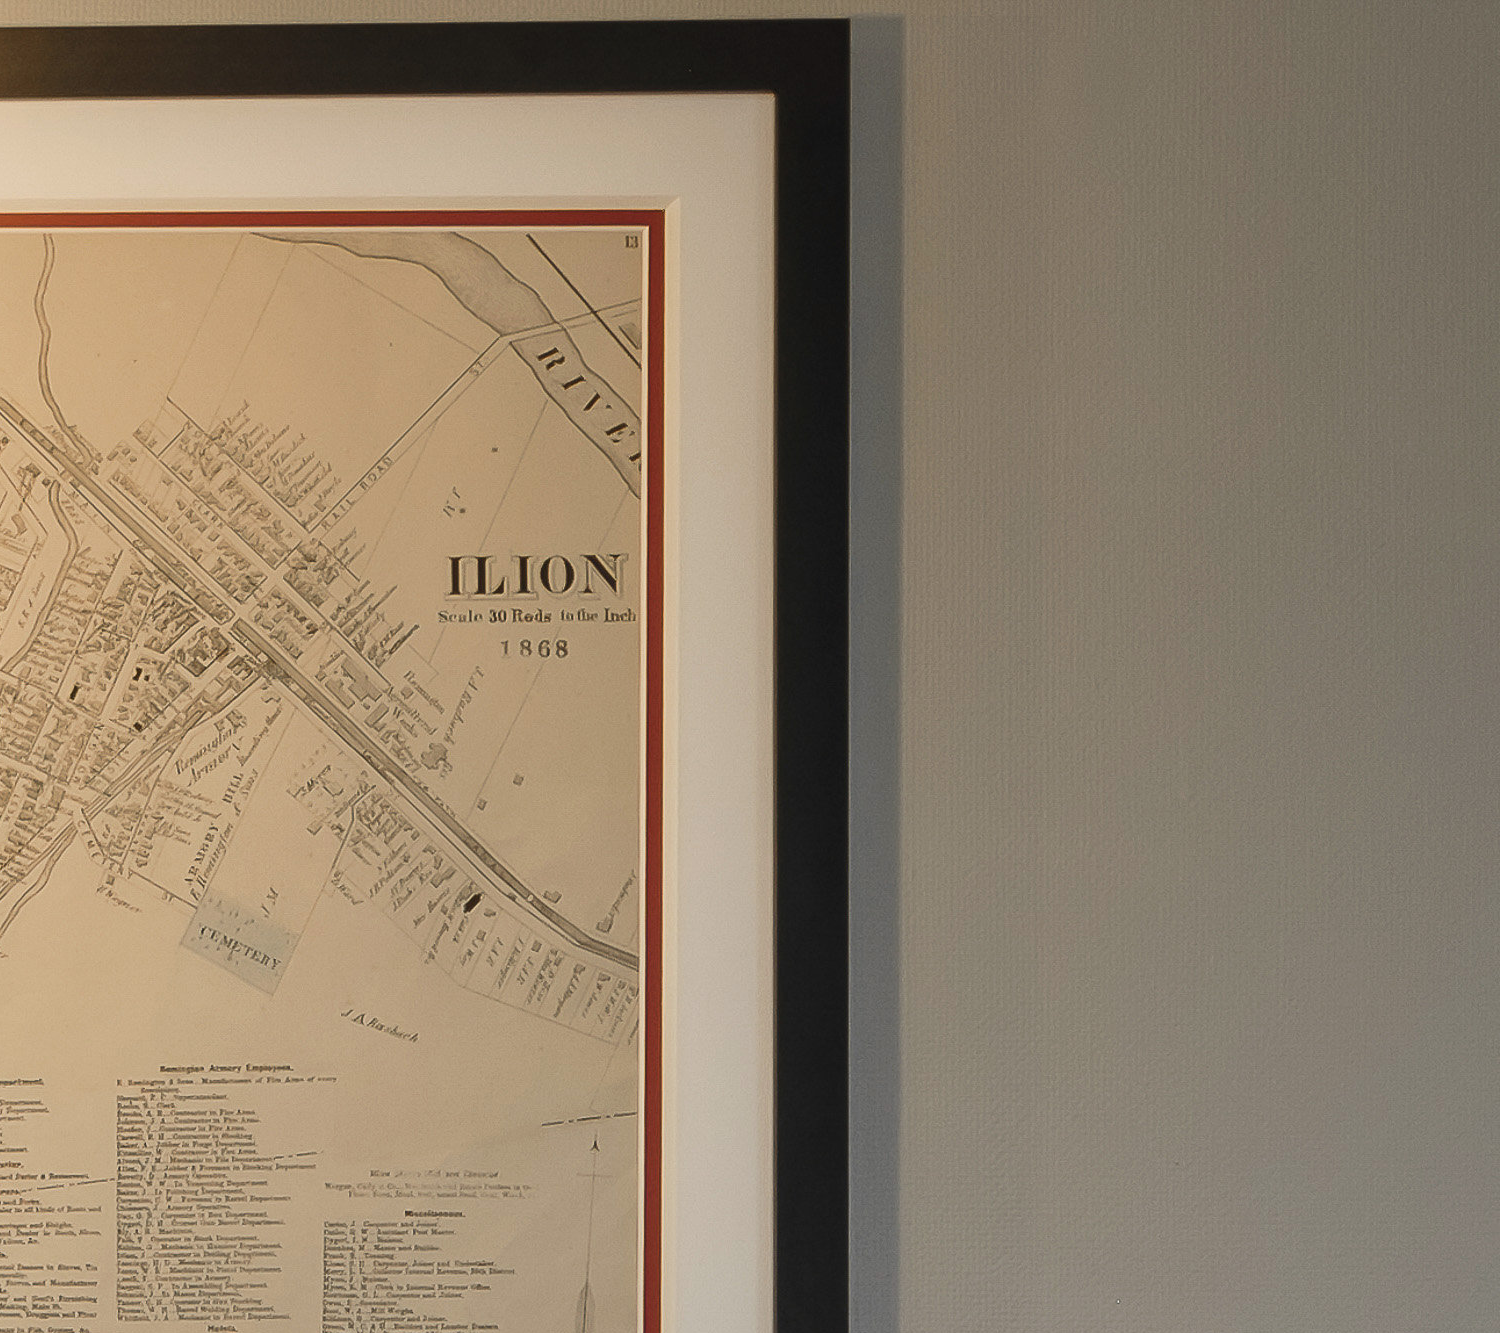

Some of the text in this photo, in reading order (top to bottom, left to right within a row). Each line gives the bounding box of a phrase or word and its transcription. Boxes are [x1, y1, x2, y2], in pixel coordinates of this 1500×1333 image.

[446, 554, 629, 600] ILION
[438, 610, 483, 623] Scale
[489, 610, 507, 623] 30
[500, 639, 569, 659] 1868
